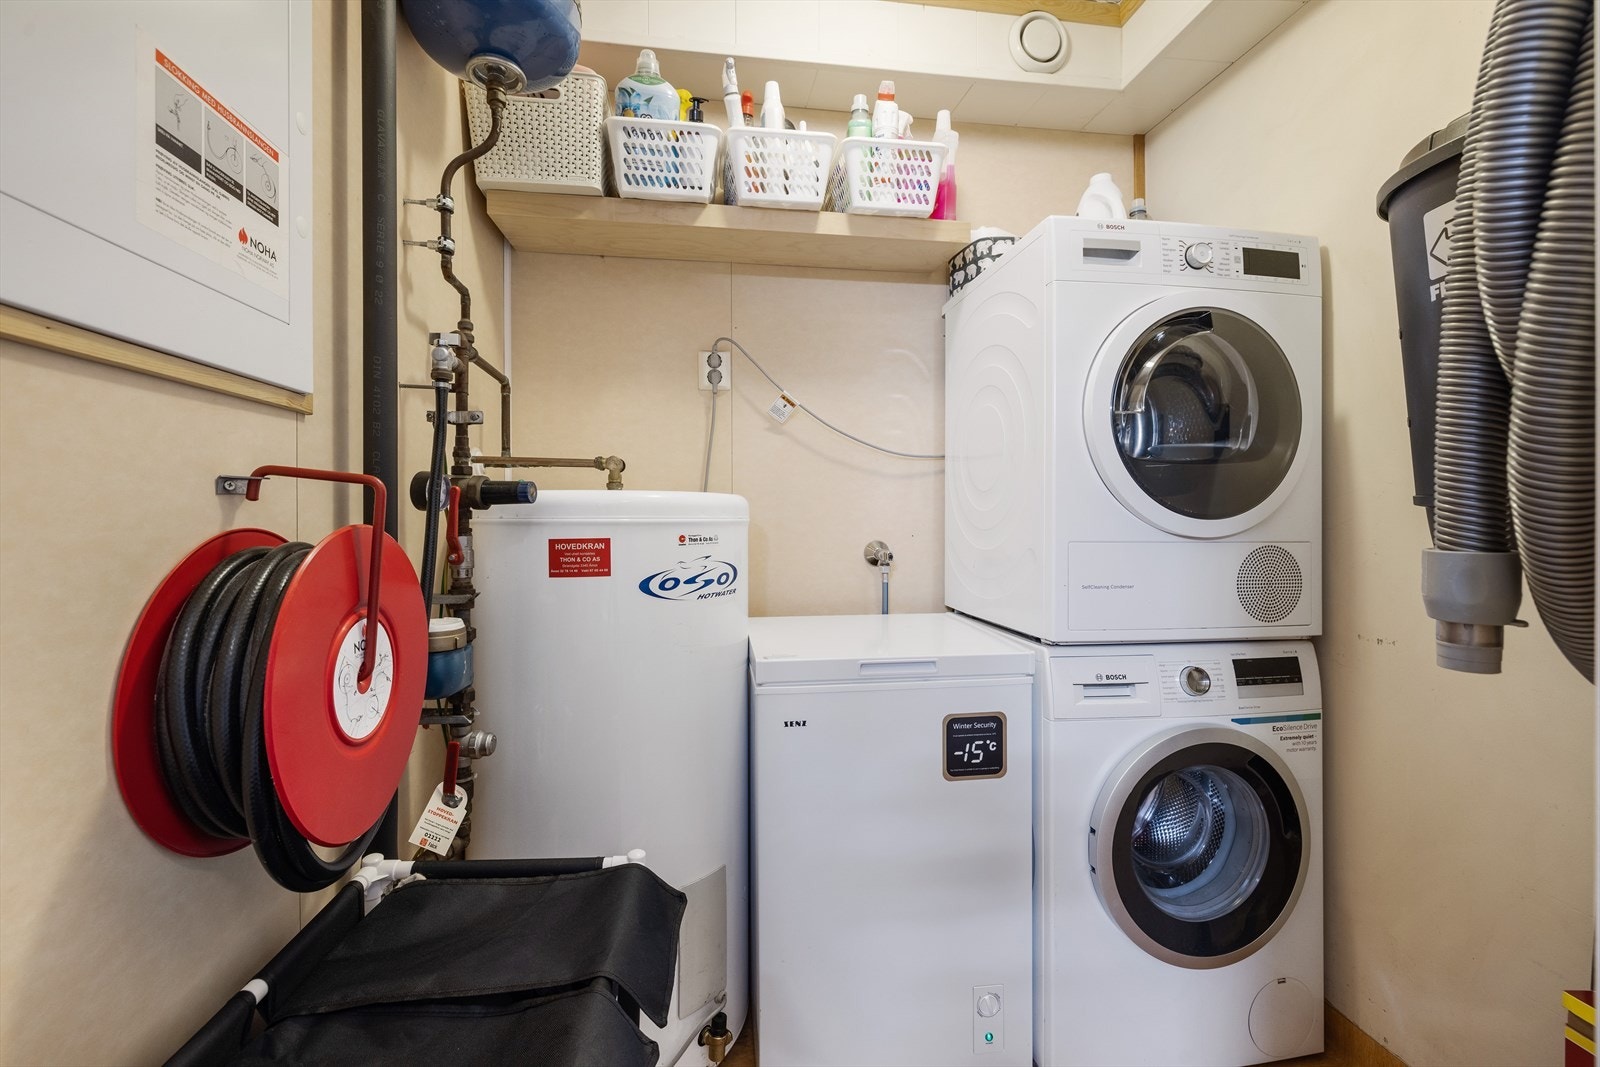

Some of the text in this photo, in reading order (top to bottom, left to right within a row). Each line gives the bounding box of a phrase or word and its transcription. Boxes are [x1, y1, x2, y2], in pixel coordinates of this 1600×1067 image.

[201, 91, 217, 108] MED
[217, 102, 275, 157] HUSBRANNSLANGEN
[375, 216, 385, 254] SERIE
[250, 236, 277, 262] NOHA
[375, 259, 385, 268] 9
[374, 288, 384, 304] 22
[1429, 281, 1447, 302] F
[372, 355, 382, 379] DIN
[371, 385, 381, 415] 4102
[555, 542, 605, 550] HOVEDKRAN
[697, 588, 737, 600] HOTWATER
[953, 721, 997, 730] Winter Security
[1272, 724, 1303, 732] EcoSilence
[424, 832, 442, 843] 02222
